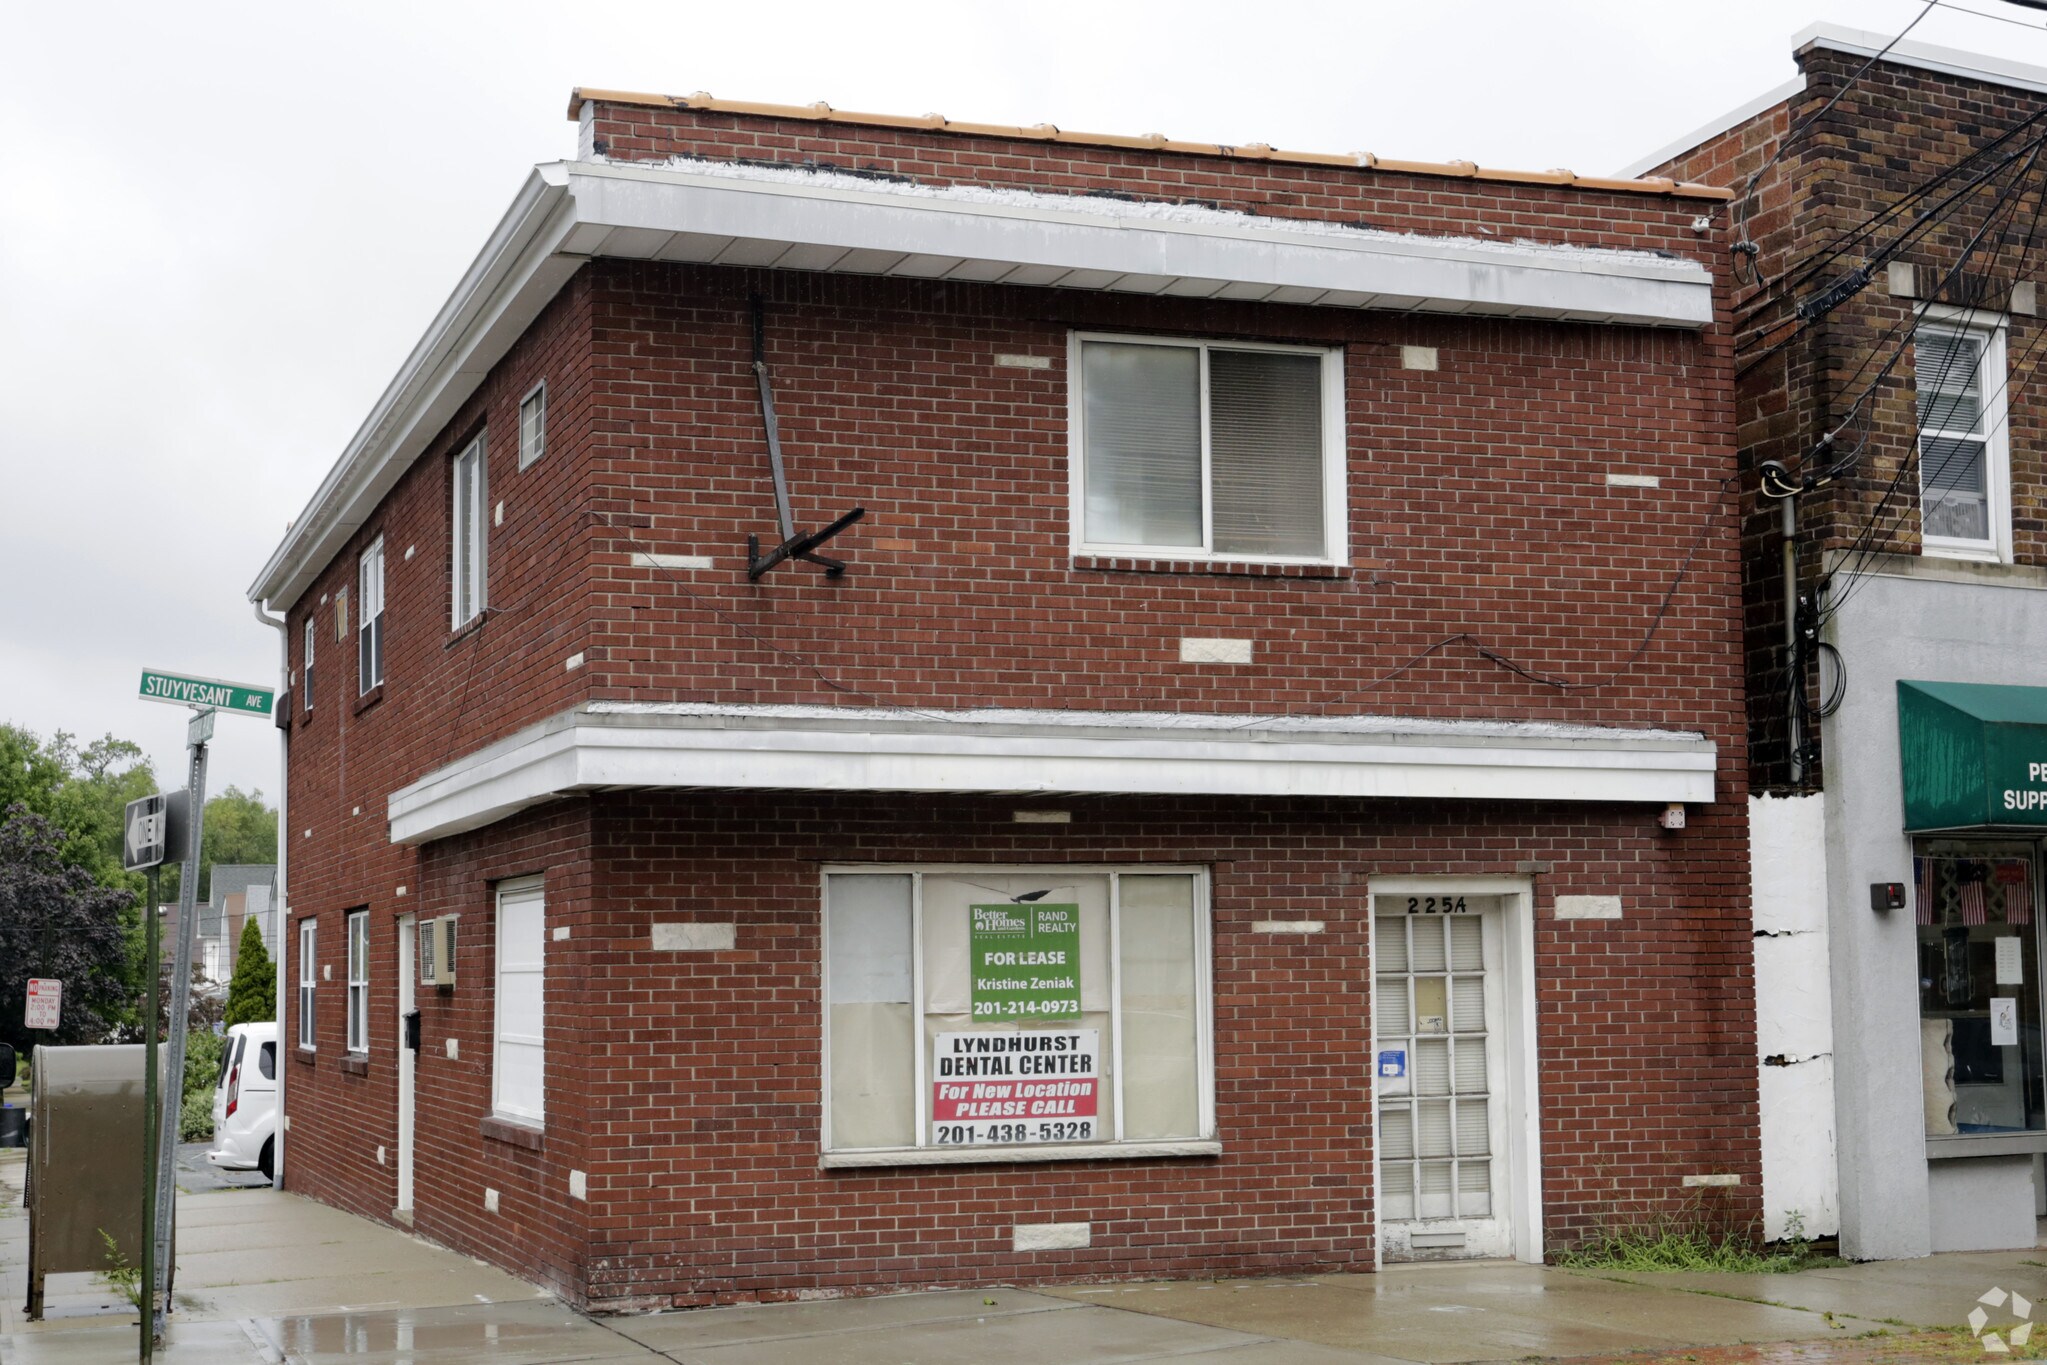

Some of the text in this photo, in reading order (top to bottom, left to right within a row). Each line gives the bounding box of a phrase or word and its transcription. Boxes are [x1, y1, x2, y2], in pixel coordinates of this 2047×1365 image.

[146, 676, 262, 708] STUYVESANT AVE
[1408, 897, 1466, 914] 225A
[974, 908, 1008, 920] Better
[1038, 911, 1068, 921] RAND
[985, 918, 1025, 931] Homes
[1038, 922, 1076, 933] REALTY
[984, 951, 1066, 966] FOR LEASE
[29, 982, 38, 993] NO
[977, 977, 1074, 990] Kristine Zeniak
[974, 1000, 1078, 1015] 201-214-0973
[953, 1035, 1080, 1053] LYNDHURST
[940, 1054, 1092, 1077] DENTAL CENTER
[939, 1081, 1092, 1100] For New Location
[956, 1099, 1076, 1117] PLEASE CALL
[937, 1121, 1091, 1145] 201-438-5328
